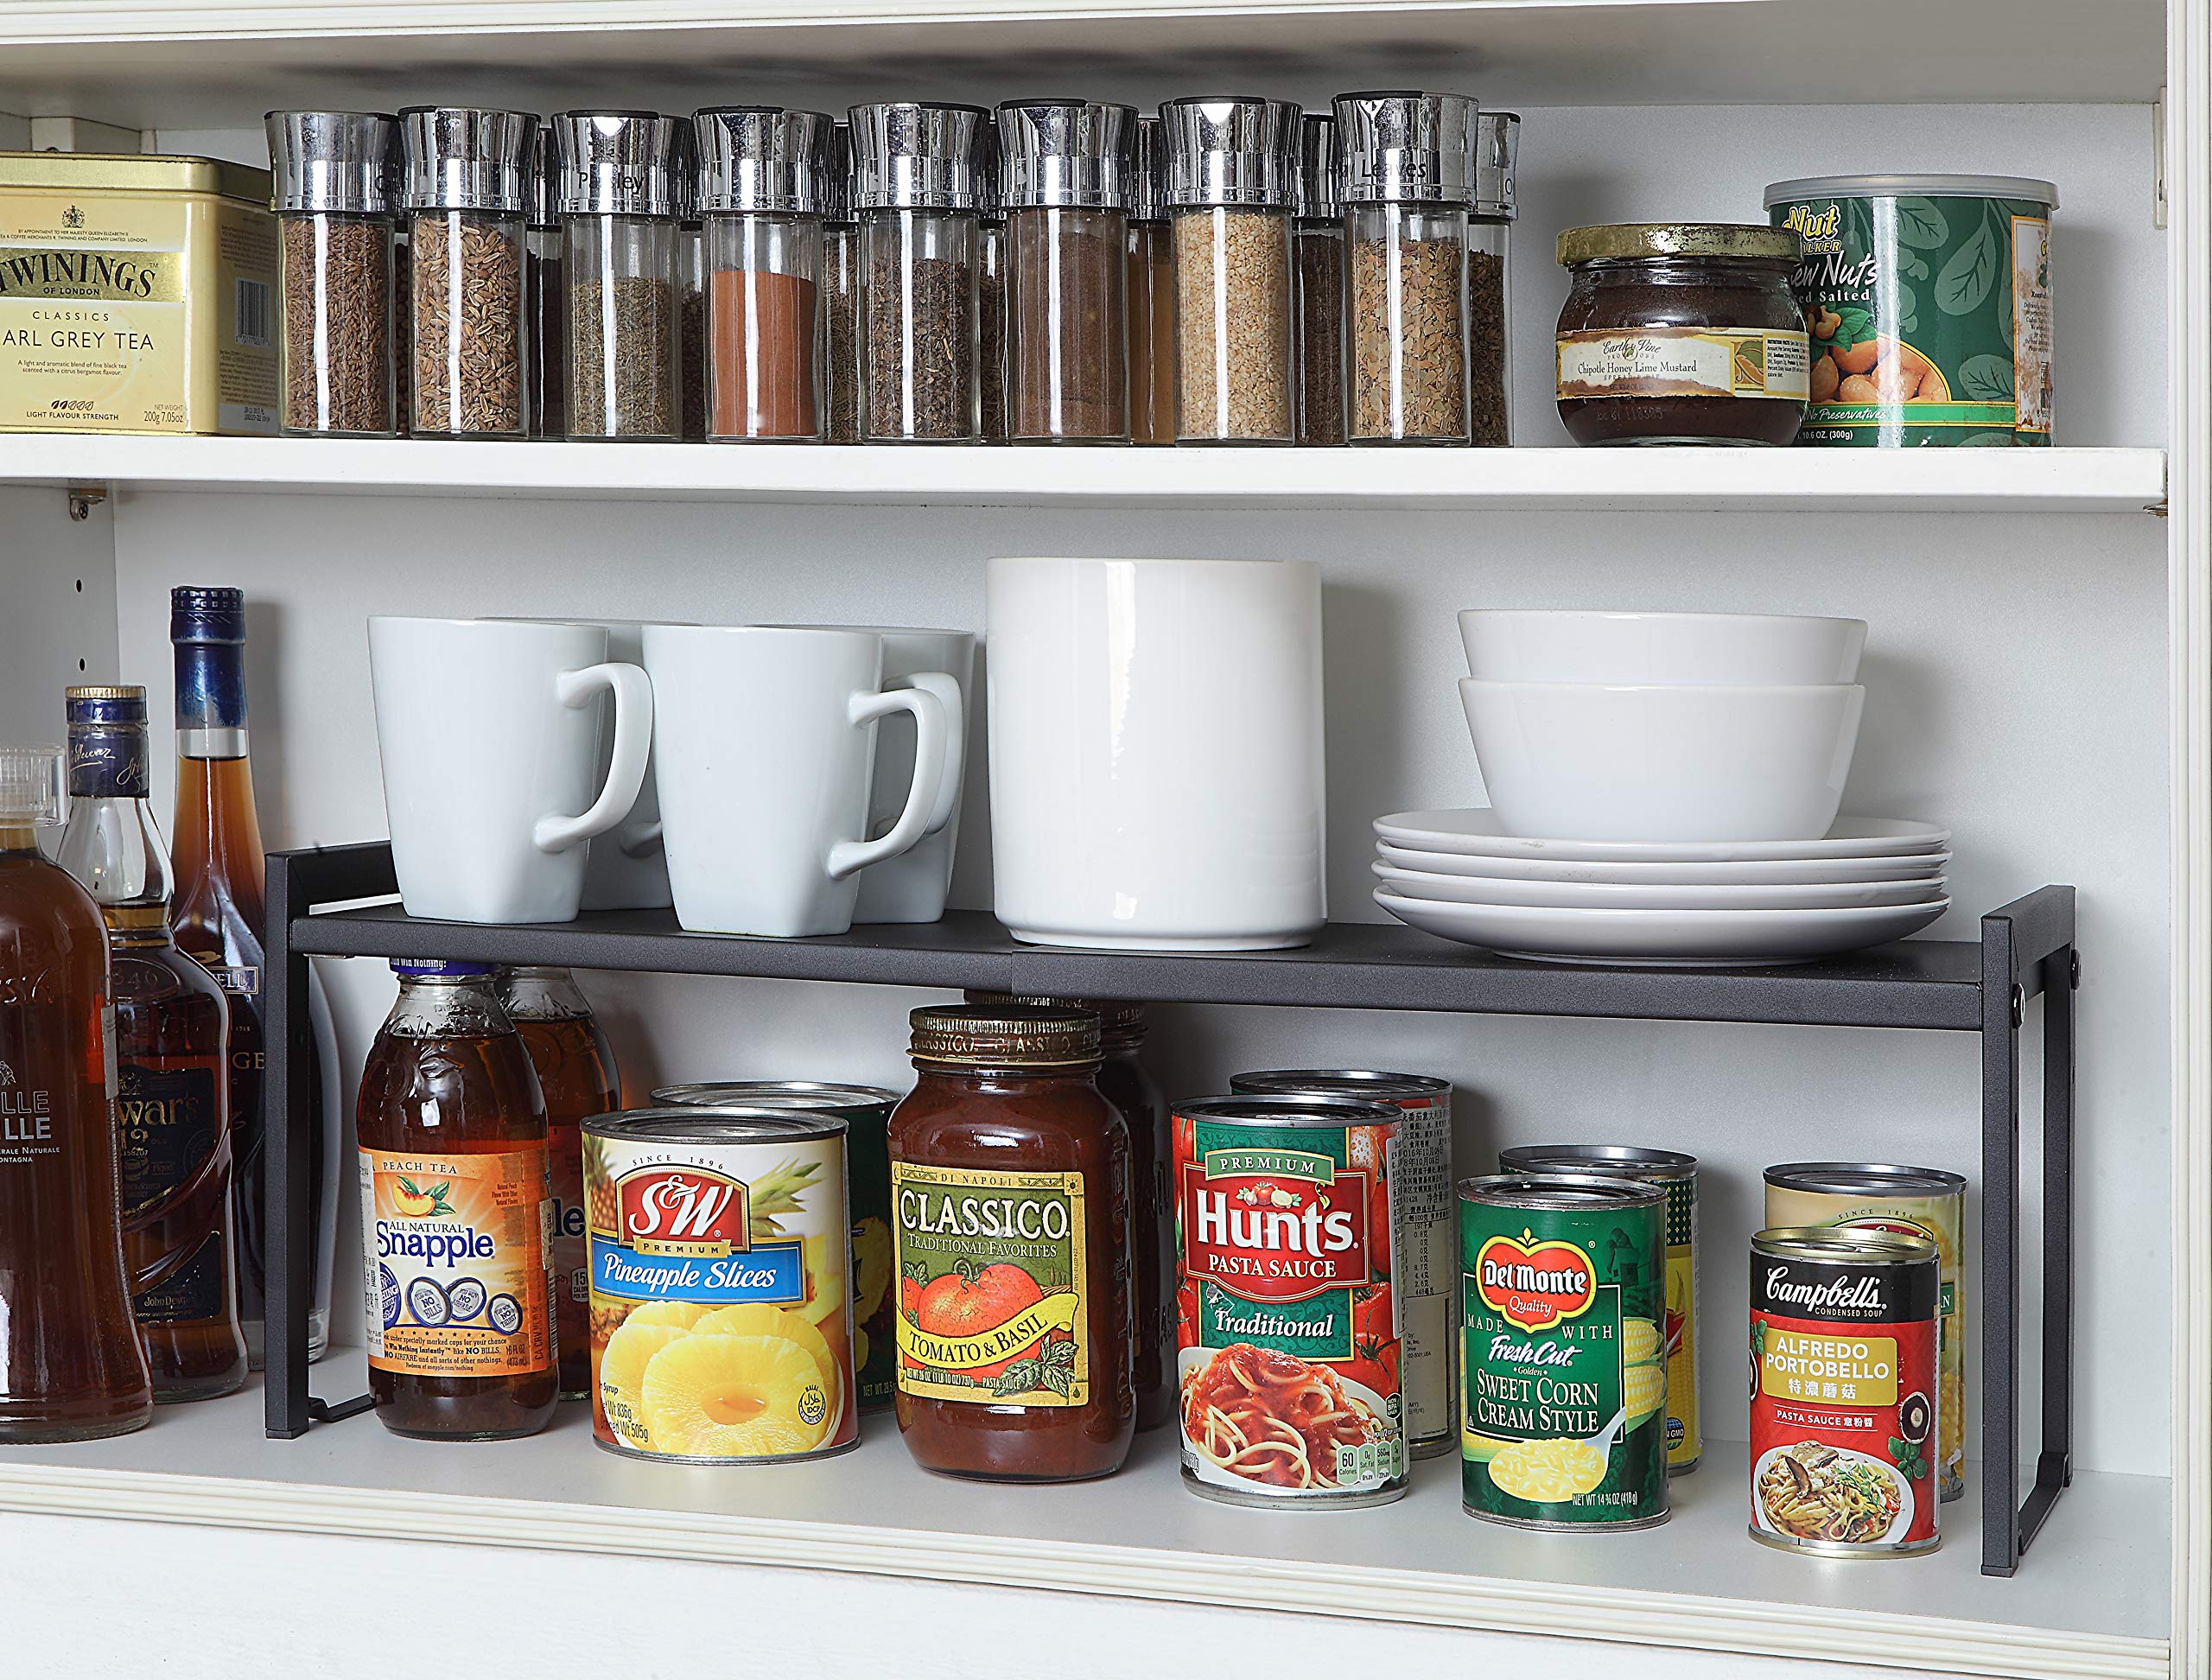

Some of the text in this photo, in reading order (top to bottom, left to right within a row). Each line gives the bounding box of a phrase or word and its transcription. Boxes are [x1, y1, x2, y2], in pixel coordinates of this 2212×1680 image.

[576, 171, 644, 195] Pley
[1789, 206, 1840, 239] Nut
[1803, 241, 1841, 253] LKER
[1821, 250, 1881, 289] Nuts
[1799, 289, 1871, 303] ed Salted
[33, 311, 109, 321] CLASSICS
[0, 329, 154, 350] ARL GREY TEA
[1638, 339, 1661, 353] Vine
[1578, 360, 1697, 376] Chipotle Honey Lime Mustard
[144, 411, 183, 424] 200g 7.05oz
[1820, 408, 1886, 421] Preservatives
[1816, 430, 1853, 440] OZ. (300g)
[215, 973, 247, 989] ELL
[0, 1091, 50, 1115] LLE
[0, 1117, 52, 1141] LLE
[383, 1161, 457, 1174] PEACH TEA
[632, 1154, 725, 1170] SINCE 1896
[1219, 1158, 1317, 1174] PREMIUM
[941, 1174, 1013, 1187] DI NAPOLI
[628, 1174, 734, 1238] S&W
[899, 1189, 1069, 1241] CLASSICO
[1838, 1209, 1914, 1220] SINCE 1896
[390, 1221, 464, 1233] ALL NATURAL
[377, 1220, 494, 1268] Snapple
[643, 1243, 720, 1254] PREMIUM
[907, 1232, 1057, 1258] TRADITIONAL FAVORITES
[604, 1253, 778, 1295] Pineapple Slices
[1208, 1253, 1338, 1279] PASTA SAUCE
[1484, 1259, 1587, 1295] Del Monte
[1766, 1266, 1882, 1312] Campbell's
[421, 1296, 435, 1308] NO
[459, 1295, 471, 1303] NO
[1509, 1295, 1552, 1317] Quality
[423, 1303, 443, 1319] BILLS
[499, 1310, 512, 1320] NO
[1815, 1307, 1883, 1318] CONDENSED SOUP
[1216, 1307, 1334, 1337] Traditional
[1468, 1313, 1612, 1340] MADE WITH
[404, 1336, 425, 1346] specially
[909, 1312, 1049, 1364] TOMATO & BASIL
[398, 1345, 417, 1353] Nothing
[534, 1349, 543, 1360] CA
[1488, 1334, 1583, 1367] Fresh Cut
[1776, 1336, 1869, 1360] ALFREDO
[395, 1353, 417, 1362] AIRFARE
[1766, 1352, 1890, 1379] PORTOBELLO
[1517, 1366, 1542, 1376] Golden
[603, 1383, 619, 1396] Syrup
[945, 1373, 1020, 1390] 10 737g PASTA SAUCE
[1478, 1368, 1599, 1407] SWEET CORN
[1789, 1378, 1857, 1400] 特濃蘑菇
[608, 1400, 632, 1422] Wt 836g
[1478, 1397, 1599, 1433] CREAM STYLE
[1777, 1410, 1841, 1427] PASTA SAUCE
[620, 1421, 630, 1436] Wt
[631, 1422, 648, 1442] 505g
[1671, 1429, 1683, 1438] GMO
[1342, 1452, 1354, 1467] 60
[1573, 1491, 1631, 1507] NET WT 14 OZ (418
